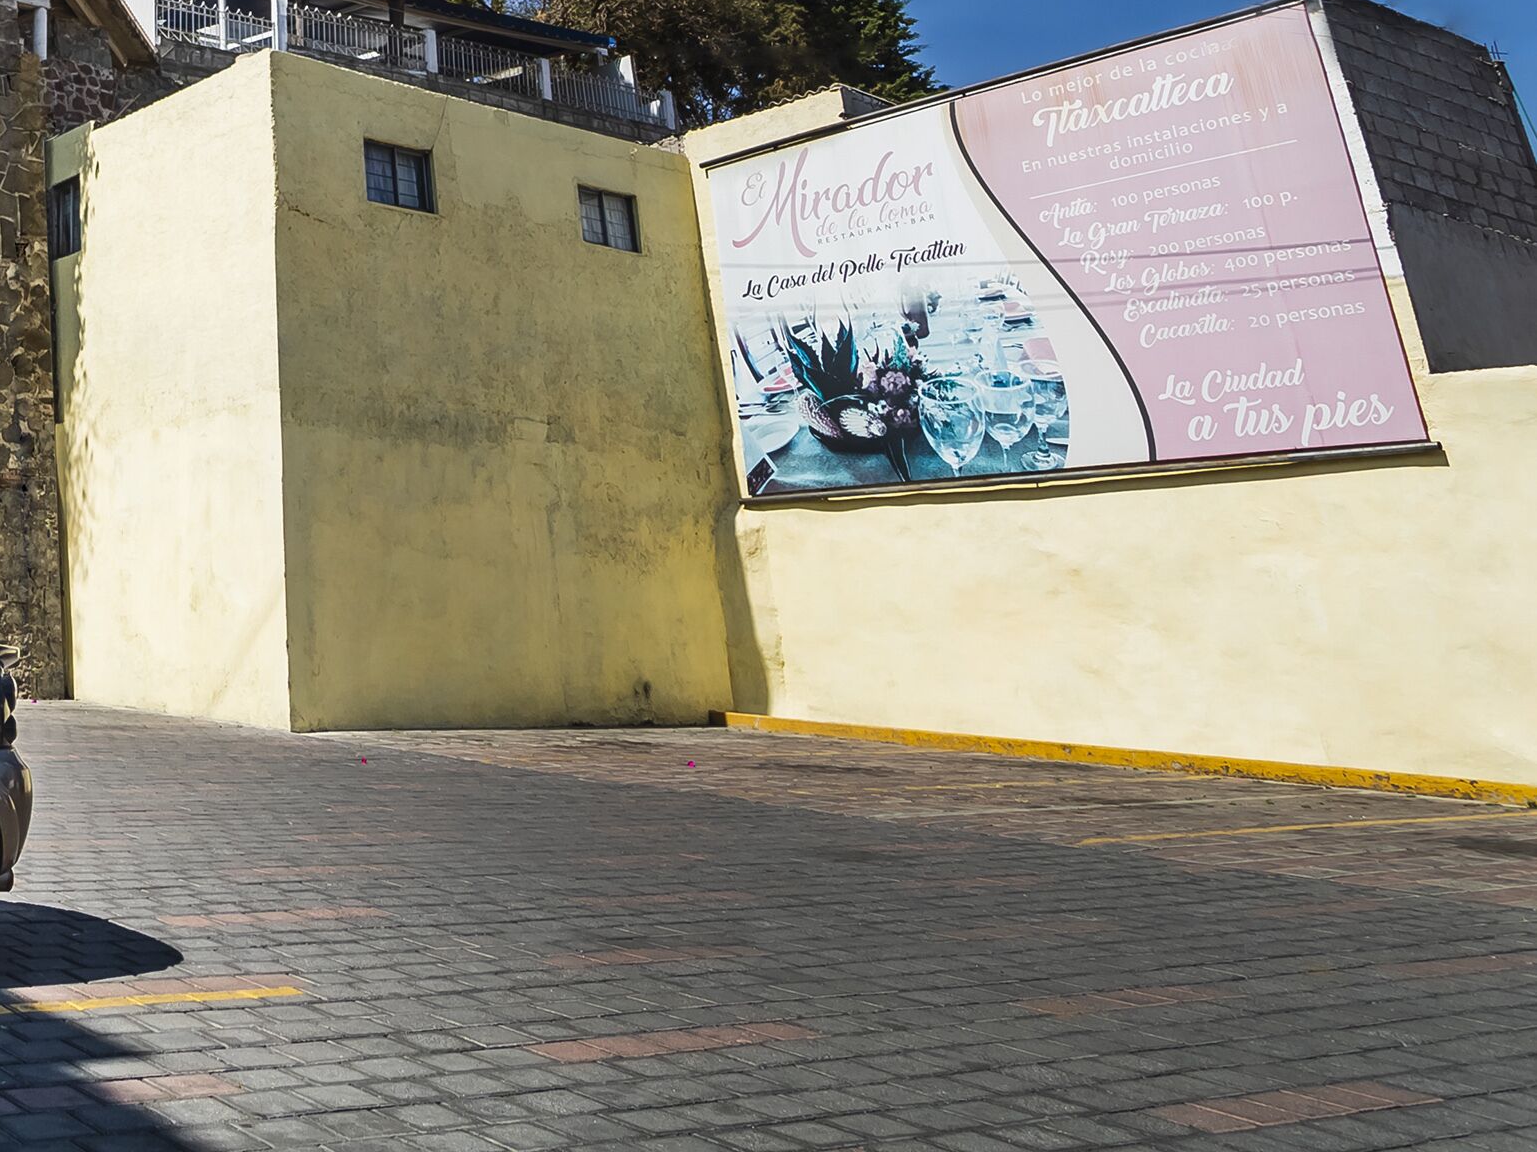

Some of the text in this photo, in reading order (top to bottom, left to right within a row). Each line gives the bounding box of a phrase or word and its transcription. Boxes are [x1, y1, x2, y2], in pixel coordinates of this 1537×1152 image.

[1021, 89, 1043, 105] Lo
[1049, 71, 1104, 97] mejor
[1109, 64, 1134, 81] de
[1139, 58, 1158, 73] la
[1031, 71, 1235, 148] Tlaxcalteca
[1021, 102, 1288, 173] En nuestras instalaciones y a
[1109, 142, 1193, 170] domicilio
[731, 146, 933, 258] Mirador
[815, 200, 933, 237] de la loma
[1038, 175, 1222, 228] Anita: 100 personas
[1058, 189, 1299, 249] La Gran Terraza: 100 p.
[1148, 242, 1180, 257] 200
[1184, 226, 1266, 254] personas
[742, 280, 763, 301] La
[766, 273, 809, 298] Casa
[811, 262, 836, 284] del
[839, 253, 886, 283] Pollo
[1104, 239, 1352, 296] Los Globos: 400 personas
[1241, 284, 1263, 298] 25
[1267, 268, 1356, 296] personas
[1249, 315, 1271, 329] 20
[1275, 300, 1365, 329] personas
[1158, 358, 1305, 406] La Ciudad
[1187, 390, 1395, 448] a tus pies
